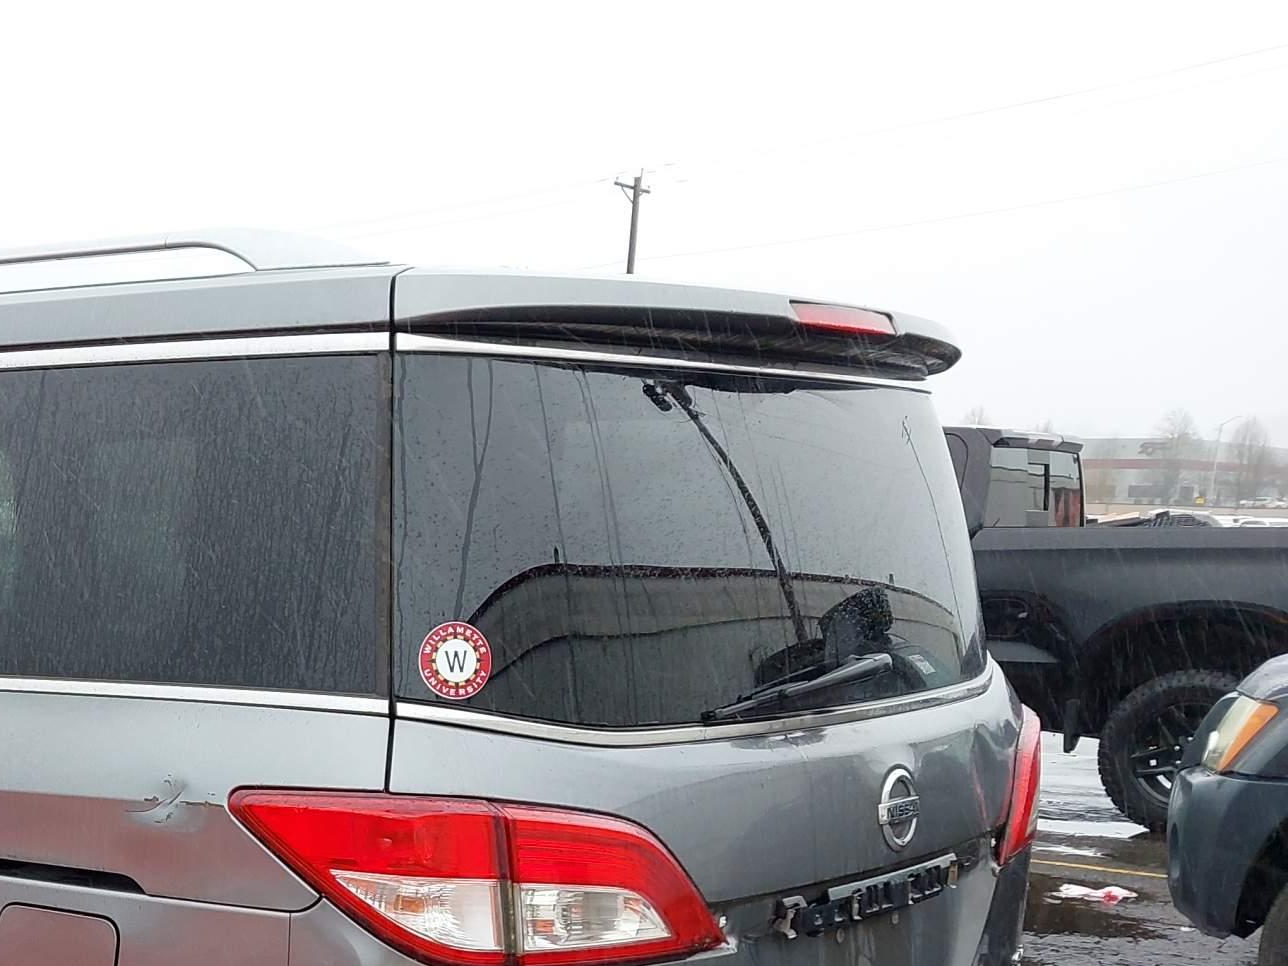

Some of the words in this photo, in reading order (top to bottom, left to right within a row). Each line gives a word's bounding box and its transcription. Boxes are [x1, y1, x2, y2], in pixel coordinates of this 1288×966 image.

[423, 626, 487, 655] WILLAMETTE
[444, 649, 468, 673] W
[424, 668, 487, 696] UNIVERSITY
